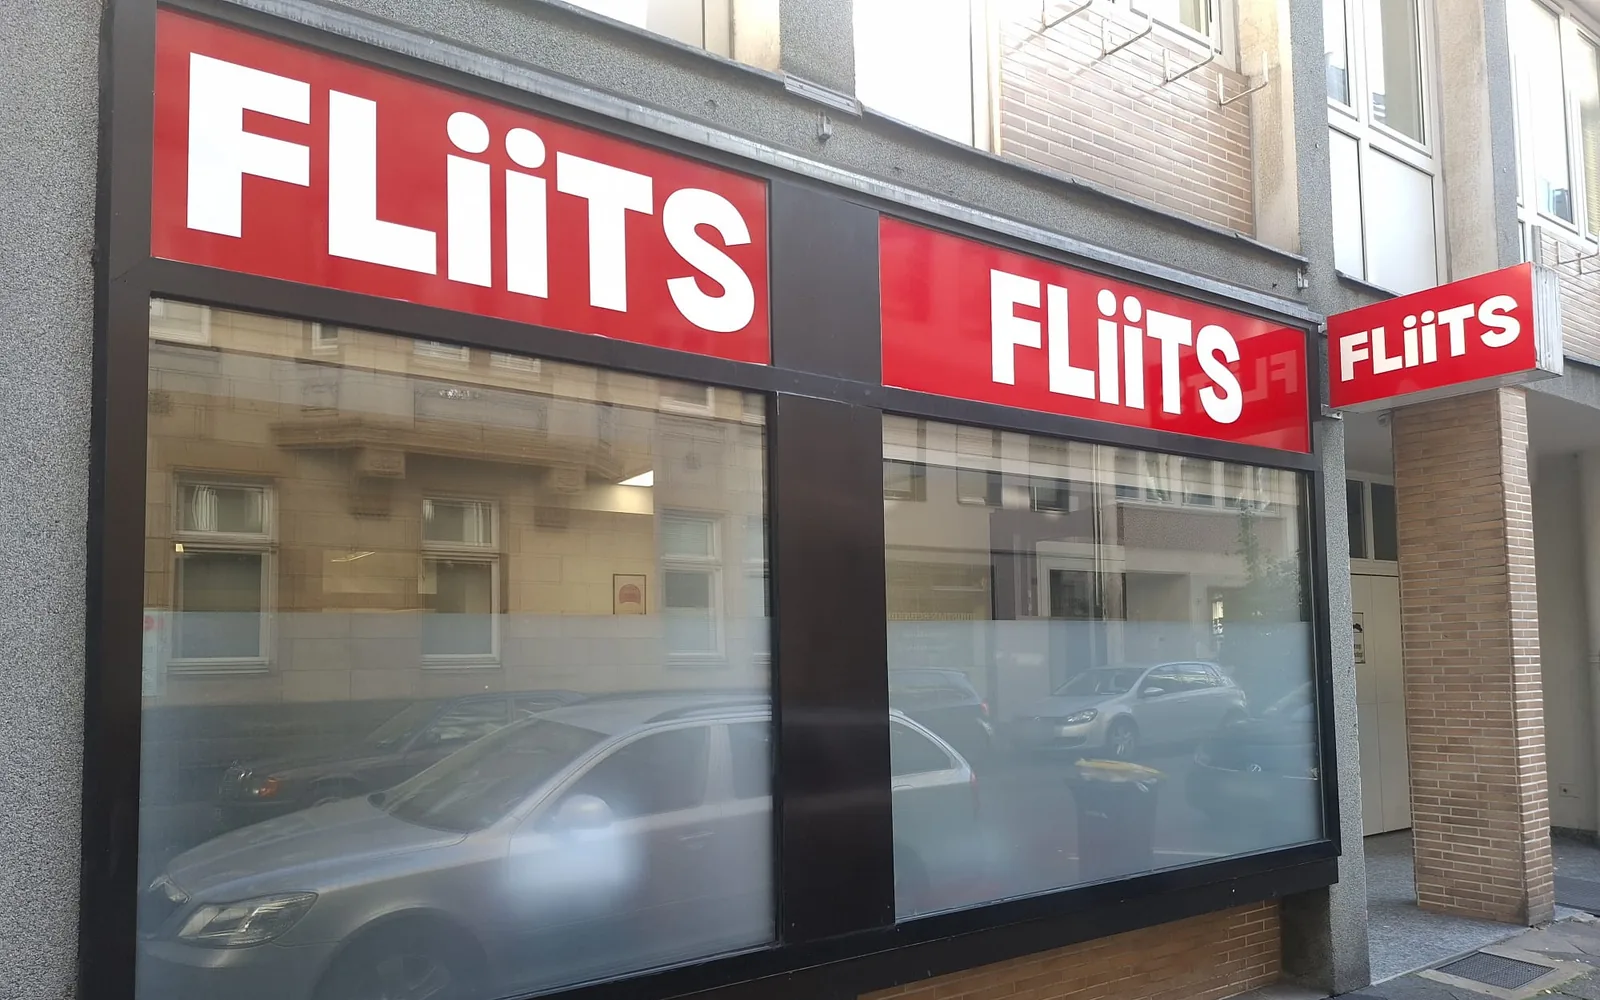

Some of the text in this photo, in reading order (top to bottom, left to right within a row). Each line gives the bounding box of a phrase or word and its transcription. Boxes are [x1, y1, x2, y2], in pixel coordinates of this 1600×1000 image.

[186, 52, 755, 333] FLiiTS
[990, 269, 1242, 424] FLiiTS
[1339, 295, 1521, 382] FLiiTS
